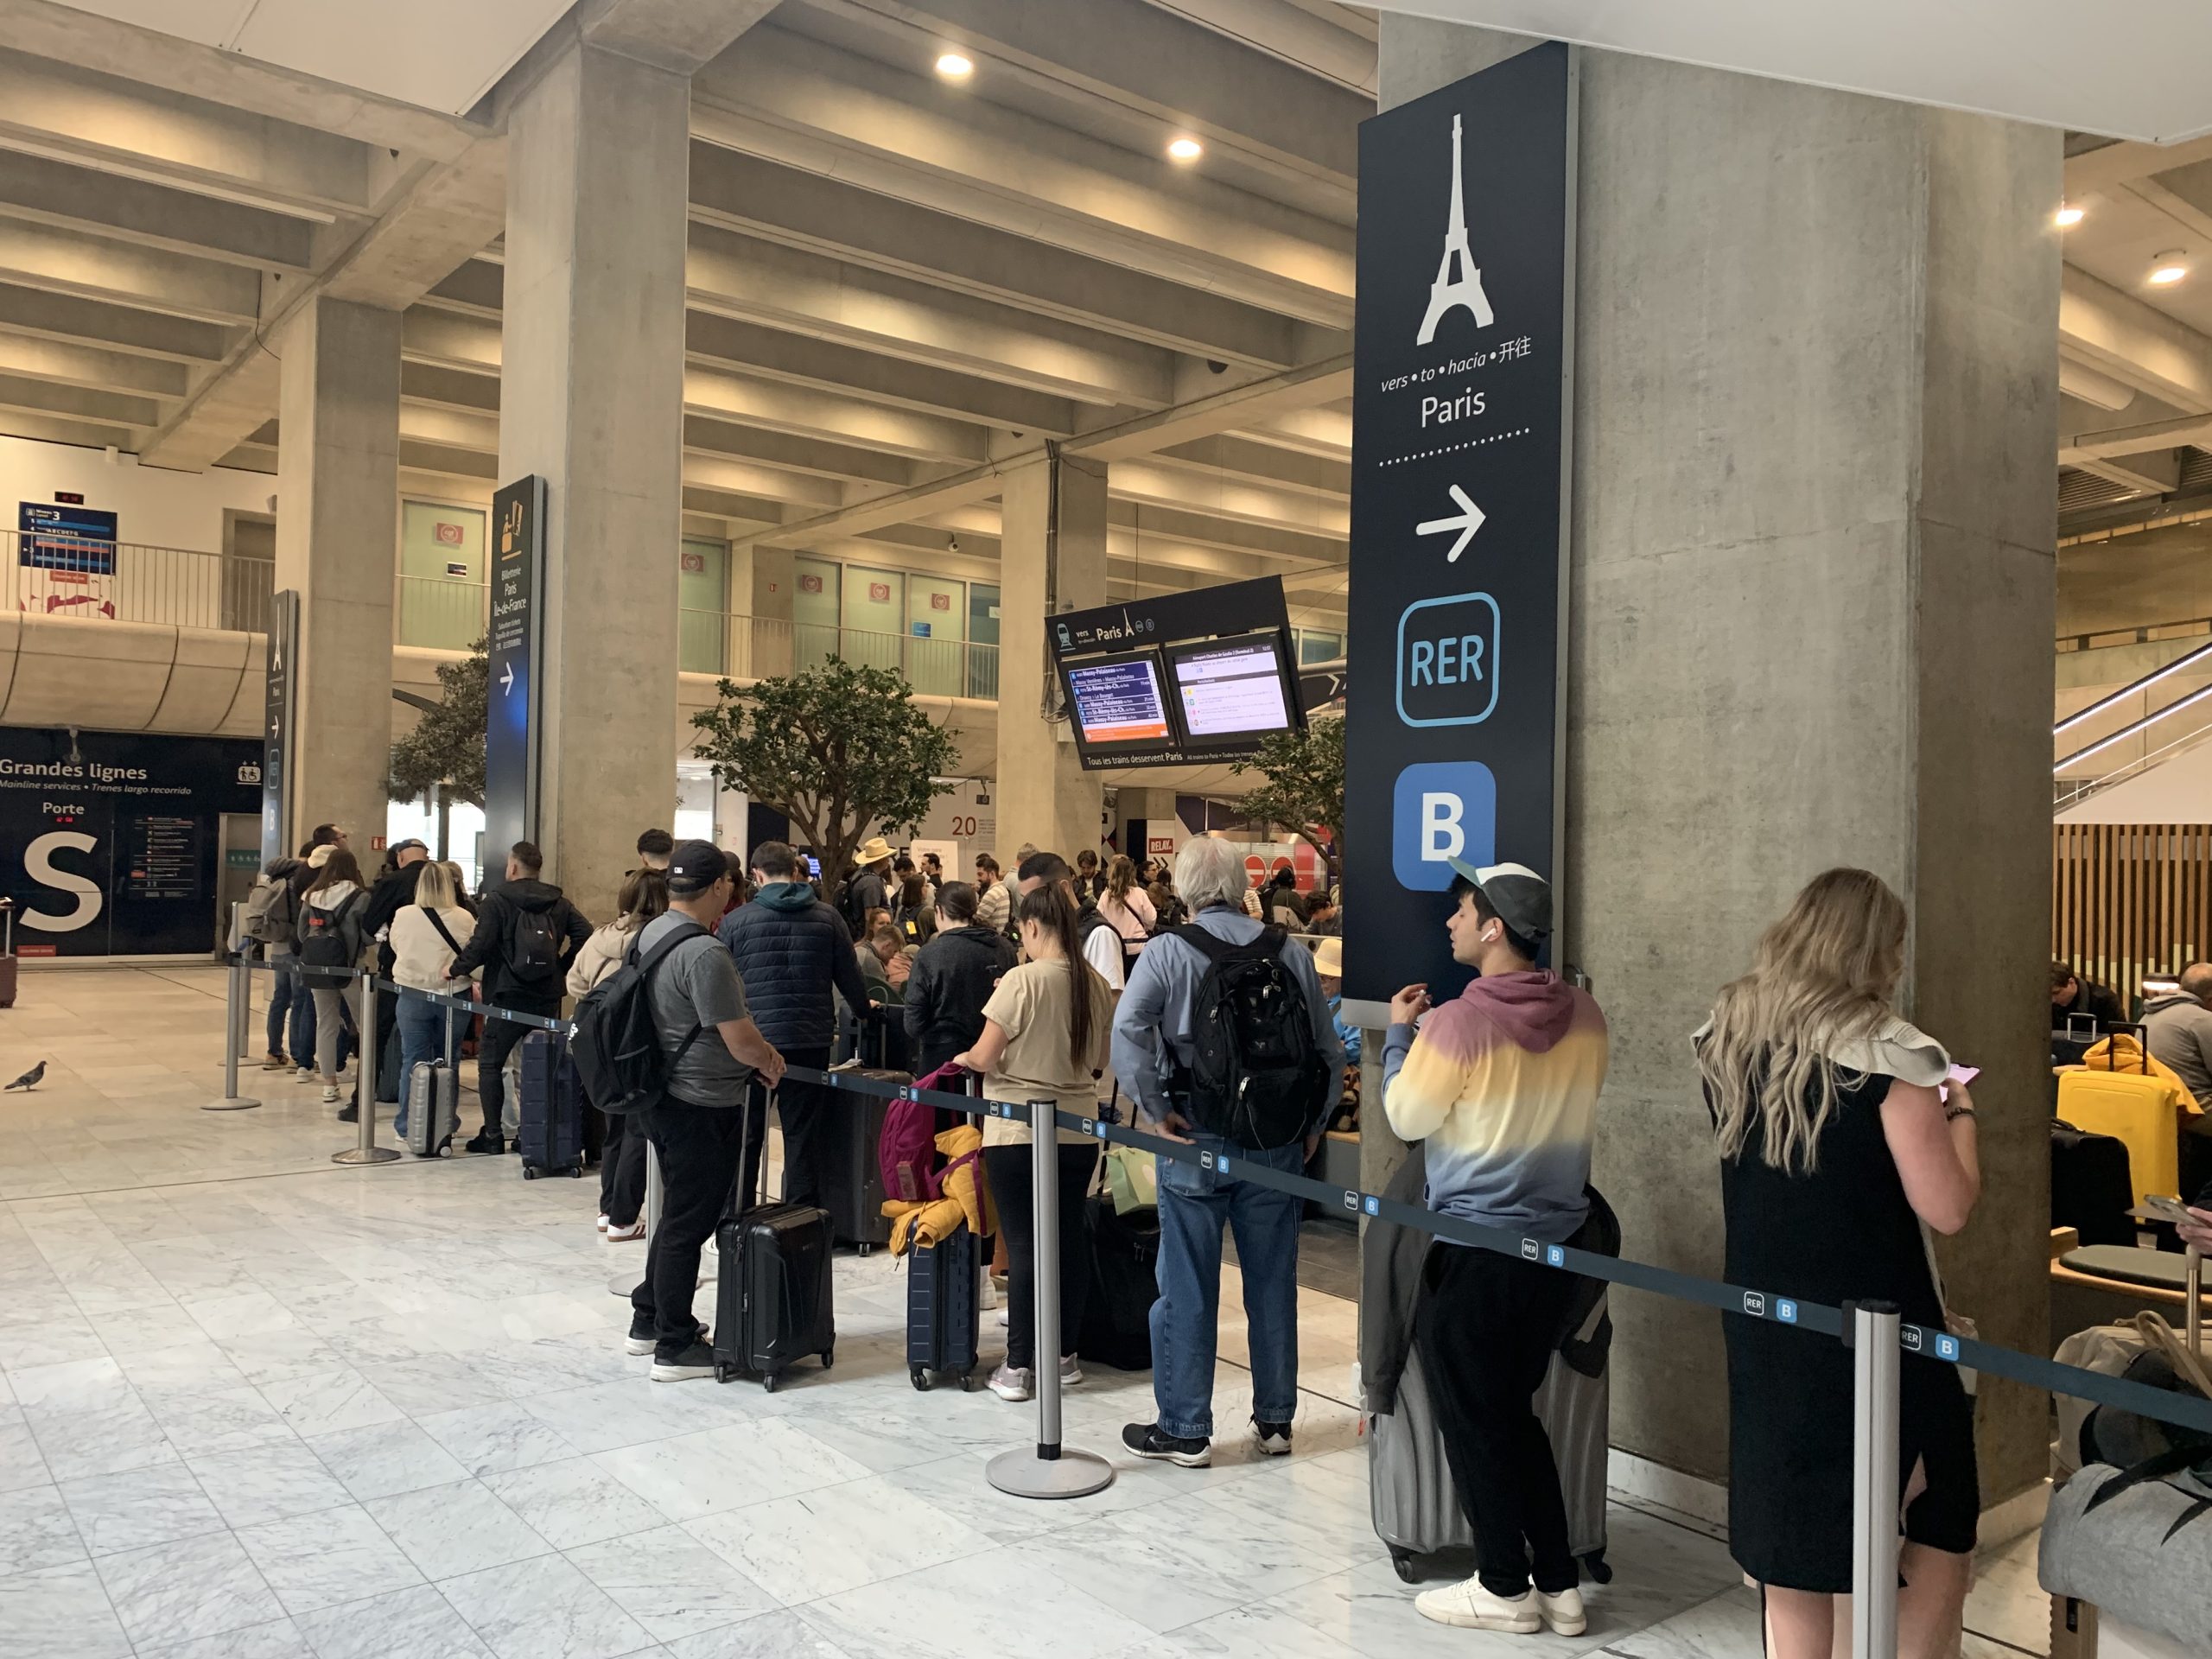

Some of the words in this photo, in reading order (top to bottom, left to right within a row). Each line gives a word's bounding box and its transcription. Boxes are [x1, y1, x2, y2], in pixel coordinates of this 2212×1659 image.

[1499, 335, 1531, 364] 开往
[1381, 373, 1408, 392] vers
[1421, 367, 1434, 382] to
[1448, 352, 1486, 375] hacia
[1421, 386, 1486, 428] Paris
[53, 511, 60, 520] 3
[505, 582, 517, 596] Paris
[493, 599, 526, 617] Île-de-France
[1096, 626, 1122, 640] Paris
[1411, 634, 1484, 687] RER
[1087, 757, 1102, 766] Tous
[1103, 756, 1111, 765] les
[1112, 755, 1129, 764] trains
[1130, 754, 1164, 763] desservent
[1165, 752, 1183, 761] Paris
[0, 759, 83, 777] Grandes
[90, 763, 147, 782] lignes
[0, 779, 41, 790] Mainline
[43, 783, 81, 791] services
[92, 783, 122, 792] Trenes
[124, 785, 148, 794] largo
[43, 803, 85, 815] Porte
[952, 817, 976, 836] 20
[1421, 791, 1465, 862] B
[19, 831, 103, 932] S
[1221, 1160, 1226, 1169] B
[1369, 1201, 1376, 1211] B
[1524, 1244, 1536, 1254] RER
[1552, 1249, 1560, 1262] B
[1746, 1298, 1762, 1309] RER
[1782, 1305, 1791, 1317] B
[1902, 1331, 1918, 1343] RER
[1942, 1341, 1952, 1354] B
